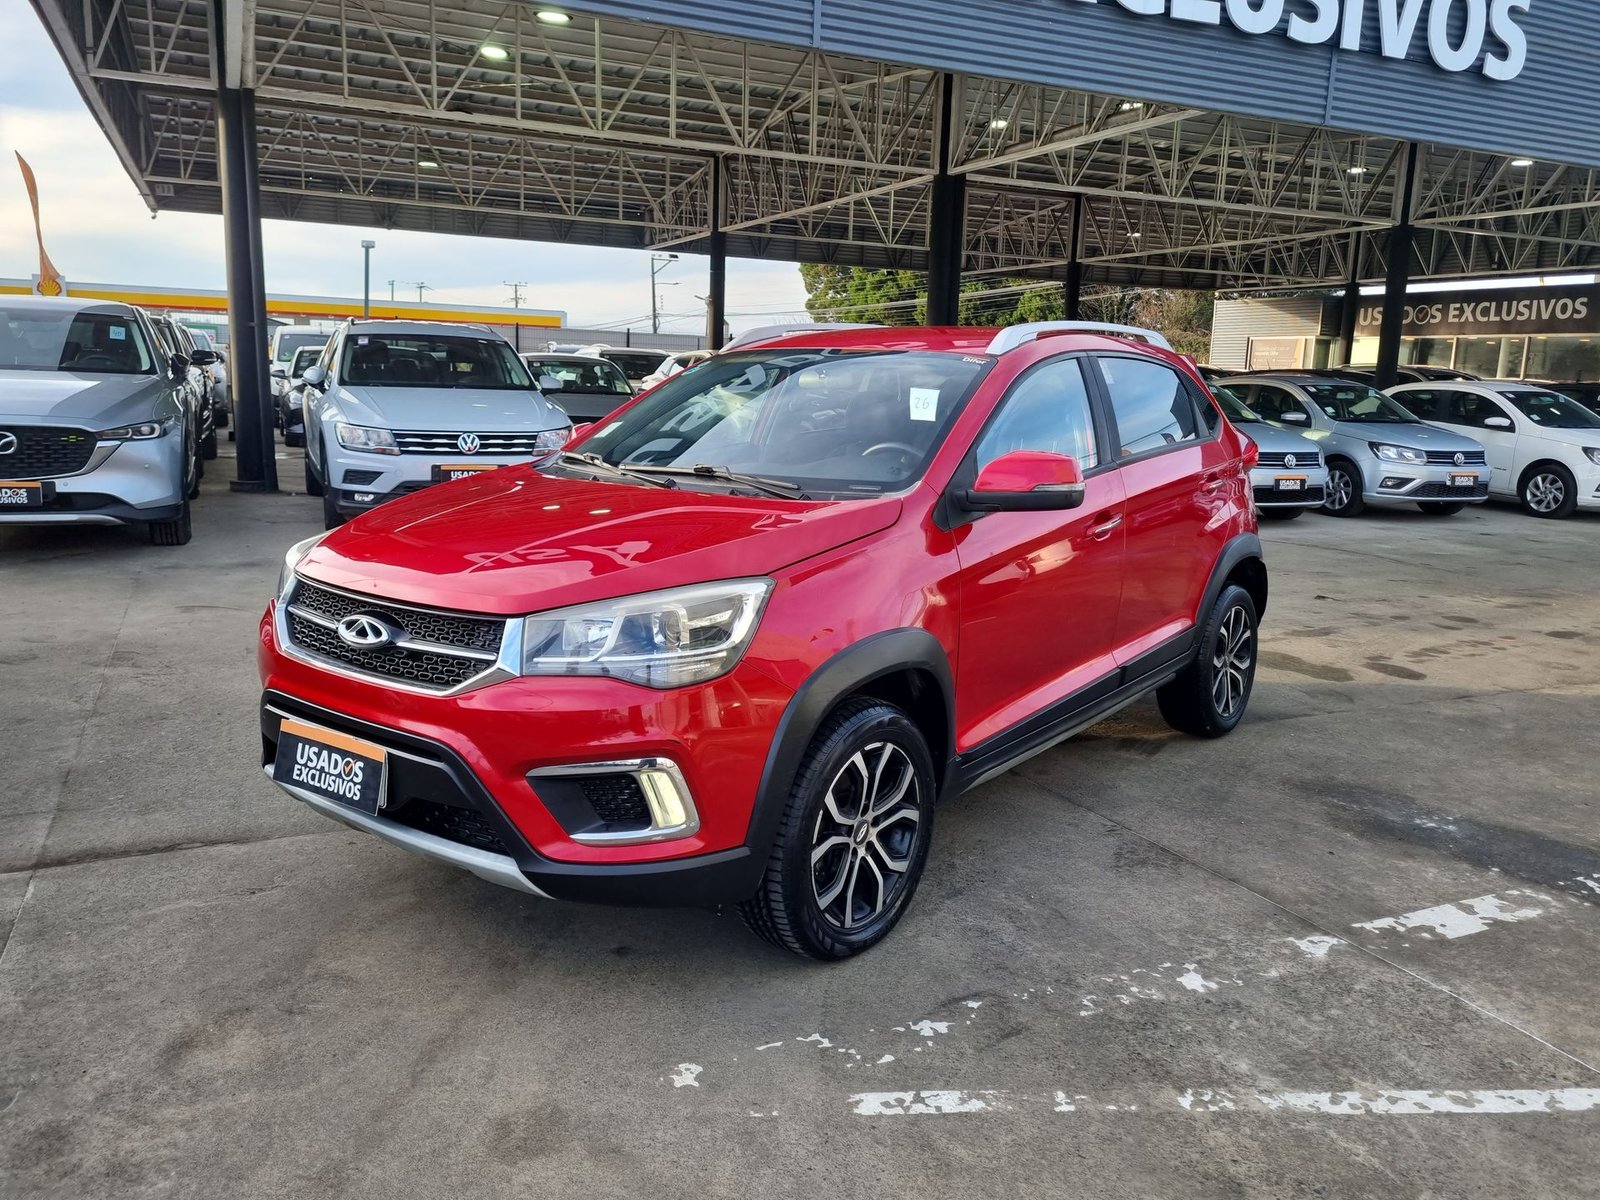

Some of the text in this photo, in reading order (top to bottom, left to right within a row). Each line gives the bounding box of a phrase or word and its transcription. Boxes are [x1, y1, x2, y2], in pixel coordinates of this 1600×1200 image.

[1358, 297, 1588, 325] USDOS EXCLUSIVOS
[914, 396, 930, 410] 26
[296, 743, 364, 783] USADOS
[292, 764, 361, 800] EXCLUSIVOS
